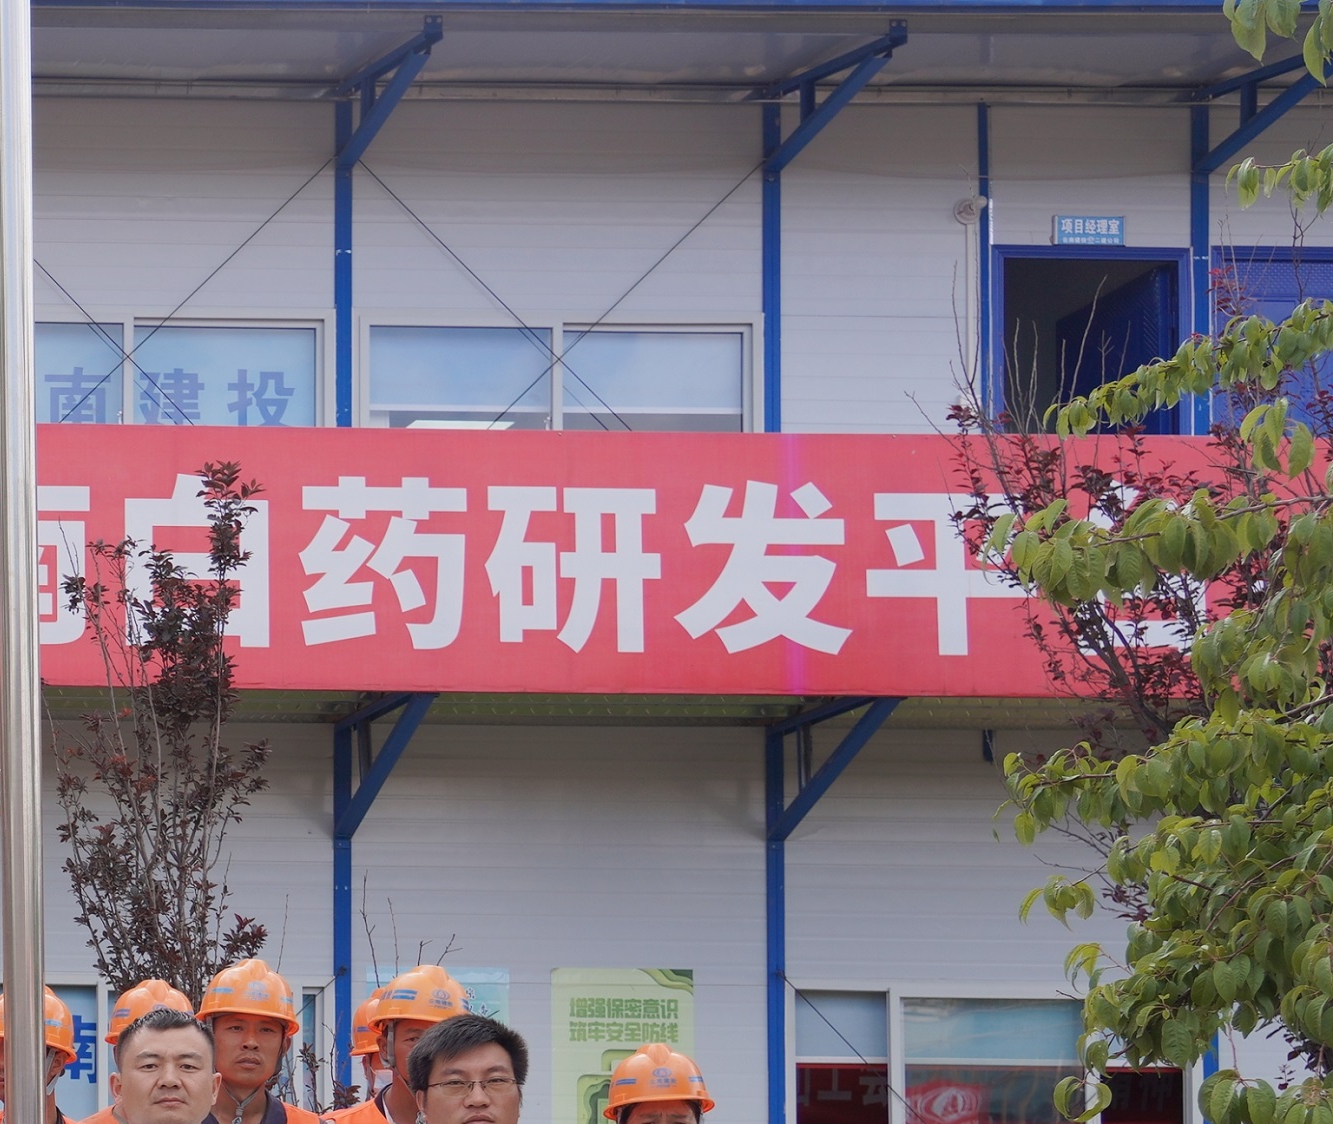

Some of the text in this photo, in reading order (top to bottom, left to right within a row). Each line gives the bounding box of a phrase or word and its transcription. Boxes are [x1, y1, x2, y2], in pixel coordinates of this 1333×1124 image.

[1062, 219, 1120, 235] 项目经理室
[569, 997, 679, 1021] 增强保密意识
[569, 1022, 679, 1044] 筑牢安全防线
